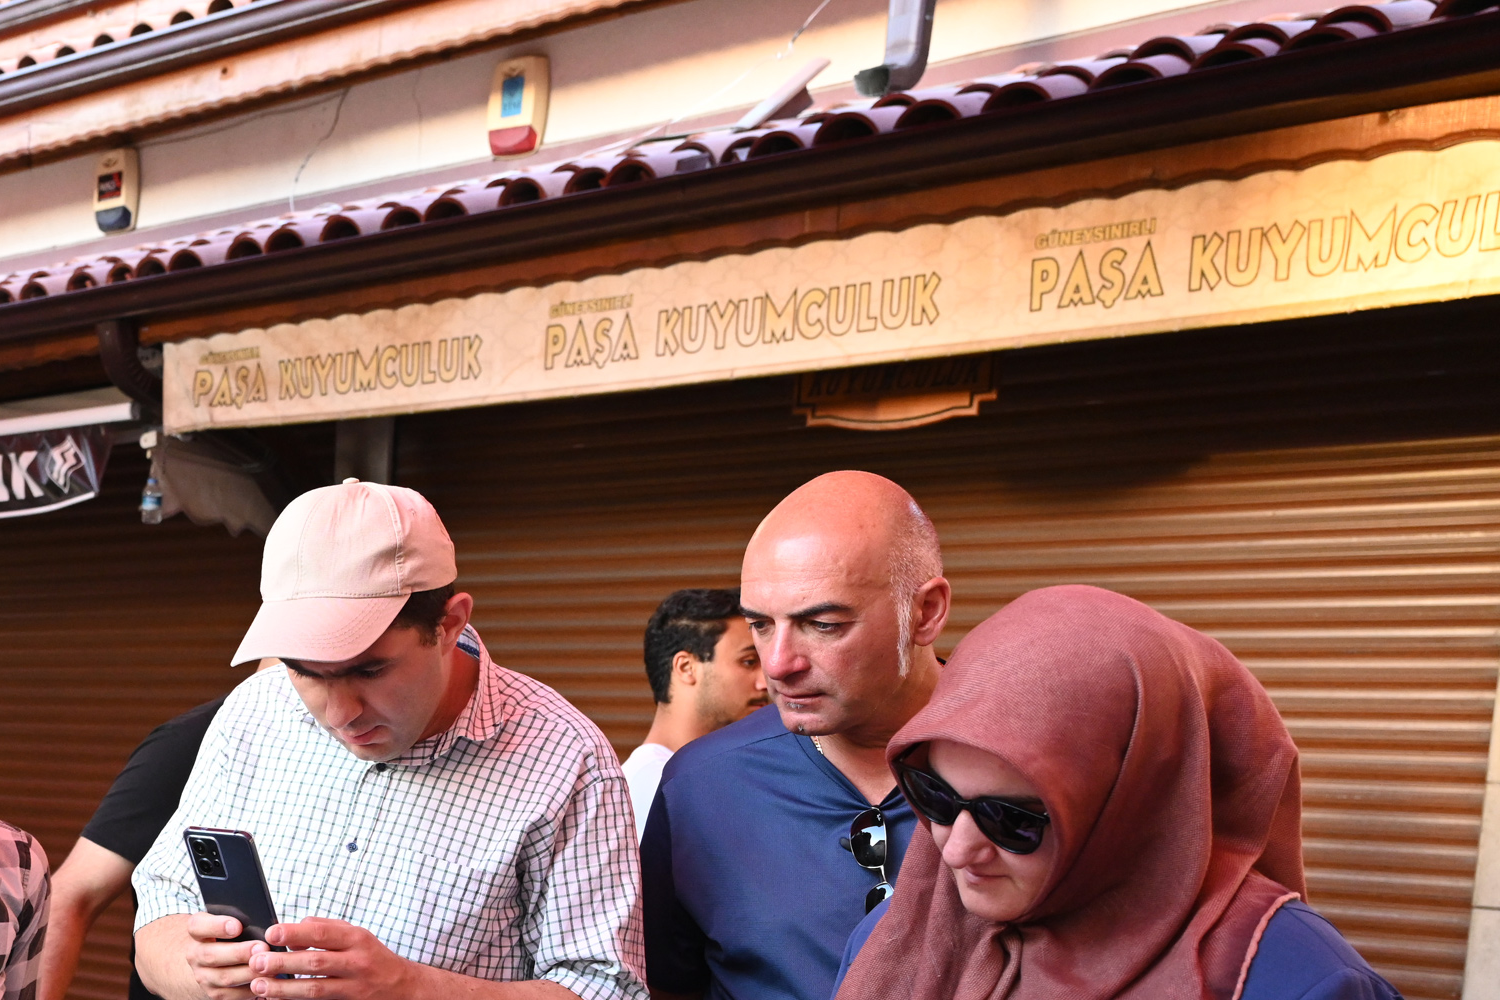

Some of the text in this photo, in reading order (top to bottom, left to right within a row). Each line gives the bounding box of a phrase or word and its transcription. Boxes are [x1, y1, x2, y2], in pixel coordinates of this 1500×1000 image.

[1029, 239, 1164, 312] PAŞA
[544, 271, 942, 370] PAŞA KUYUMCULUK
[192, 333, 484, 410] PAŞA KUYUMCULUK
